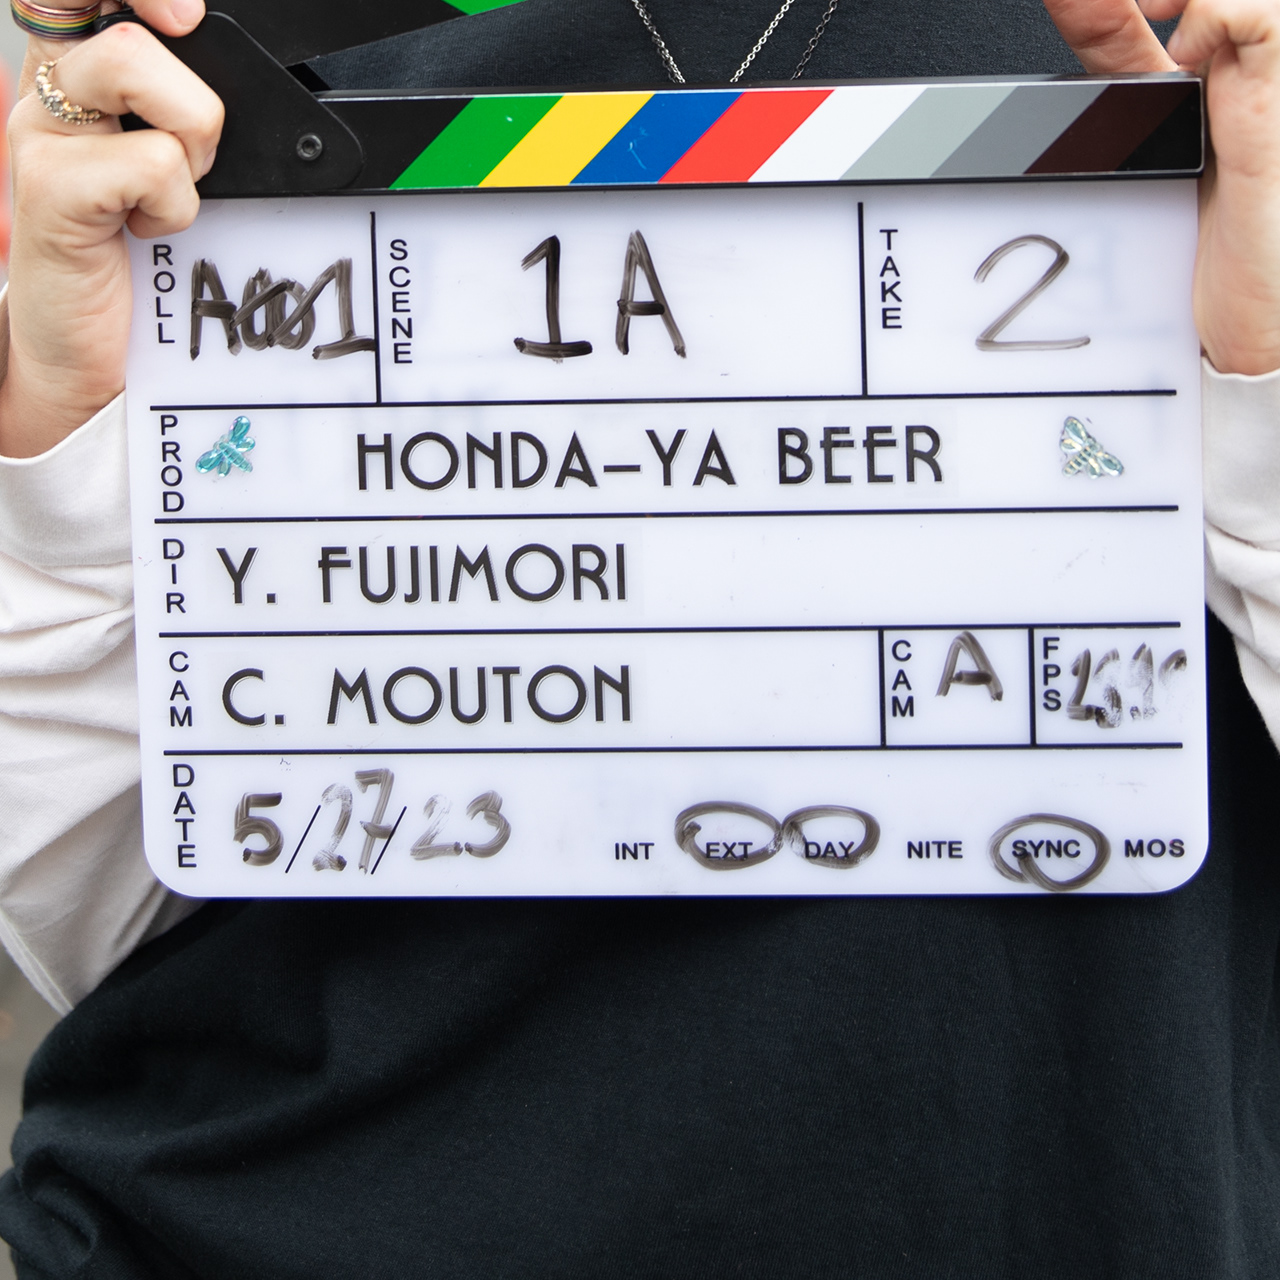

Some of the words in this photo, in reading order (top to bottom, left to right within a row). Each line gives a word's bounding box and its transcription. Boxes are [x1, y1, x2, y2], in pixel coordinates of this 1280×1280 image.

[152, 244, 176, 344] ROLL
[388, 238, 413, 364] SCENE
[879, 228, 903, 330] TAKE
[973, 233, 1092, 352] 2
[159, 414, 185, 513] PROD
[356, 428, 738, 491] HONDA-YA
[777, 424, 944, 485] BEER
[162, 538, 187, 614] DIR
[216, 547, 277, 604] Y.
[317, 543, 627, 604] FUJIMORI
[168, 650, 193, 728] CAM
[221, 667, 285, 727] C.
[326, 664, 632, 726] MOUTON
[891, 639, 915, 718] CAM
[934, 630, 1004, 702] A
[1042, 636, 1062, 712] FPS
[172, 763, 197, 868] DATE
[614, 842, 655, 861] INT
[705, 841, 754, 860] EXT
[804, 841, 855, 860] DAY
[906, 840, 964, 860] NITE
[1011, 838, 1081, 859] SYNC
[1124, 838, 1186, 859] MOS
